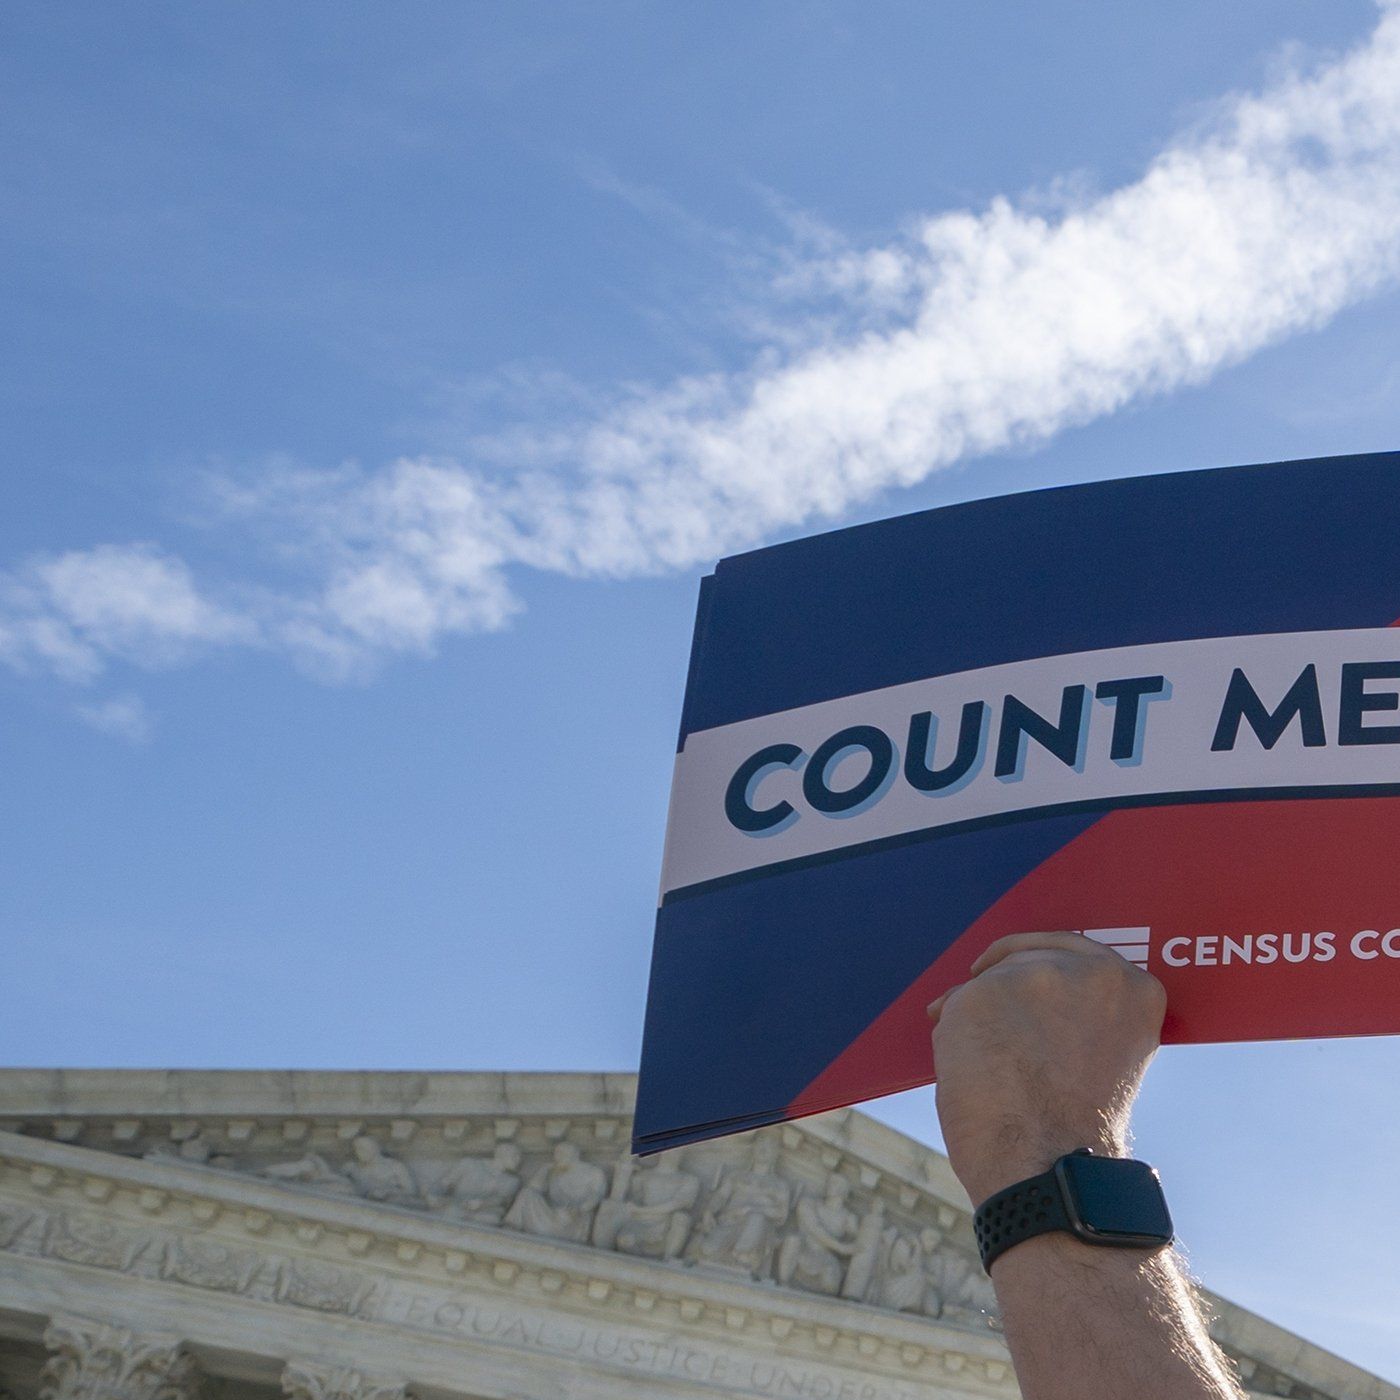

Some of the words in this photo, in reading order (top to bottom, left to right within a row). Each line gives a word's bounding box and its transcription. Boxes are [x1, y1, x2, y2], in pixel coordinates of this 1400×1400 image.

[723, 674, 1173, 840] COUNT
[1161, 930, 1337, 969] CENSUS
[404, 1297, 548, 1348] EQUAL
[558, 1328, 730, 1380] JUSTICE
